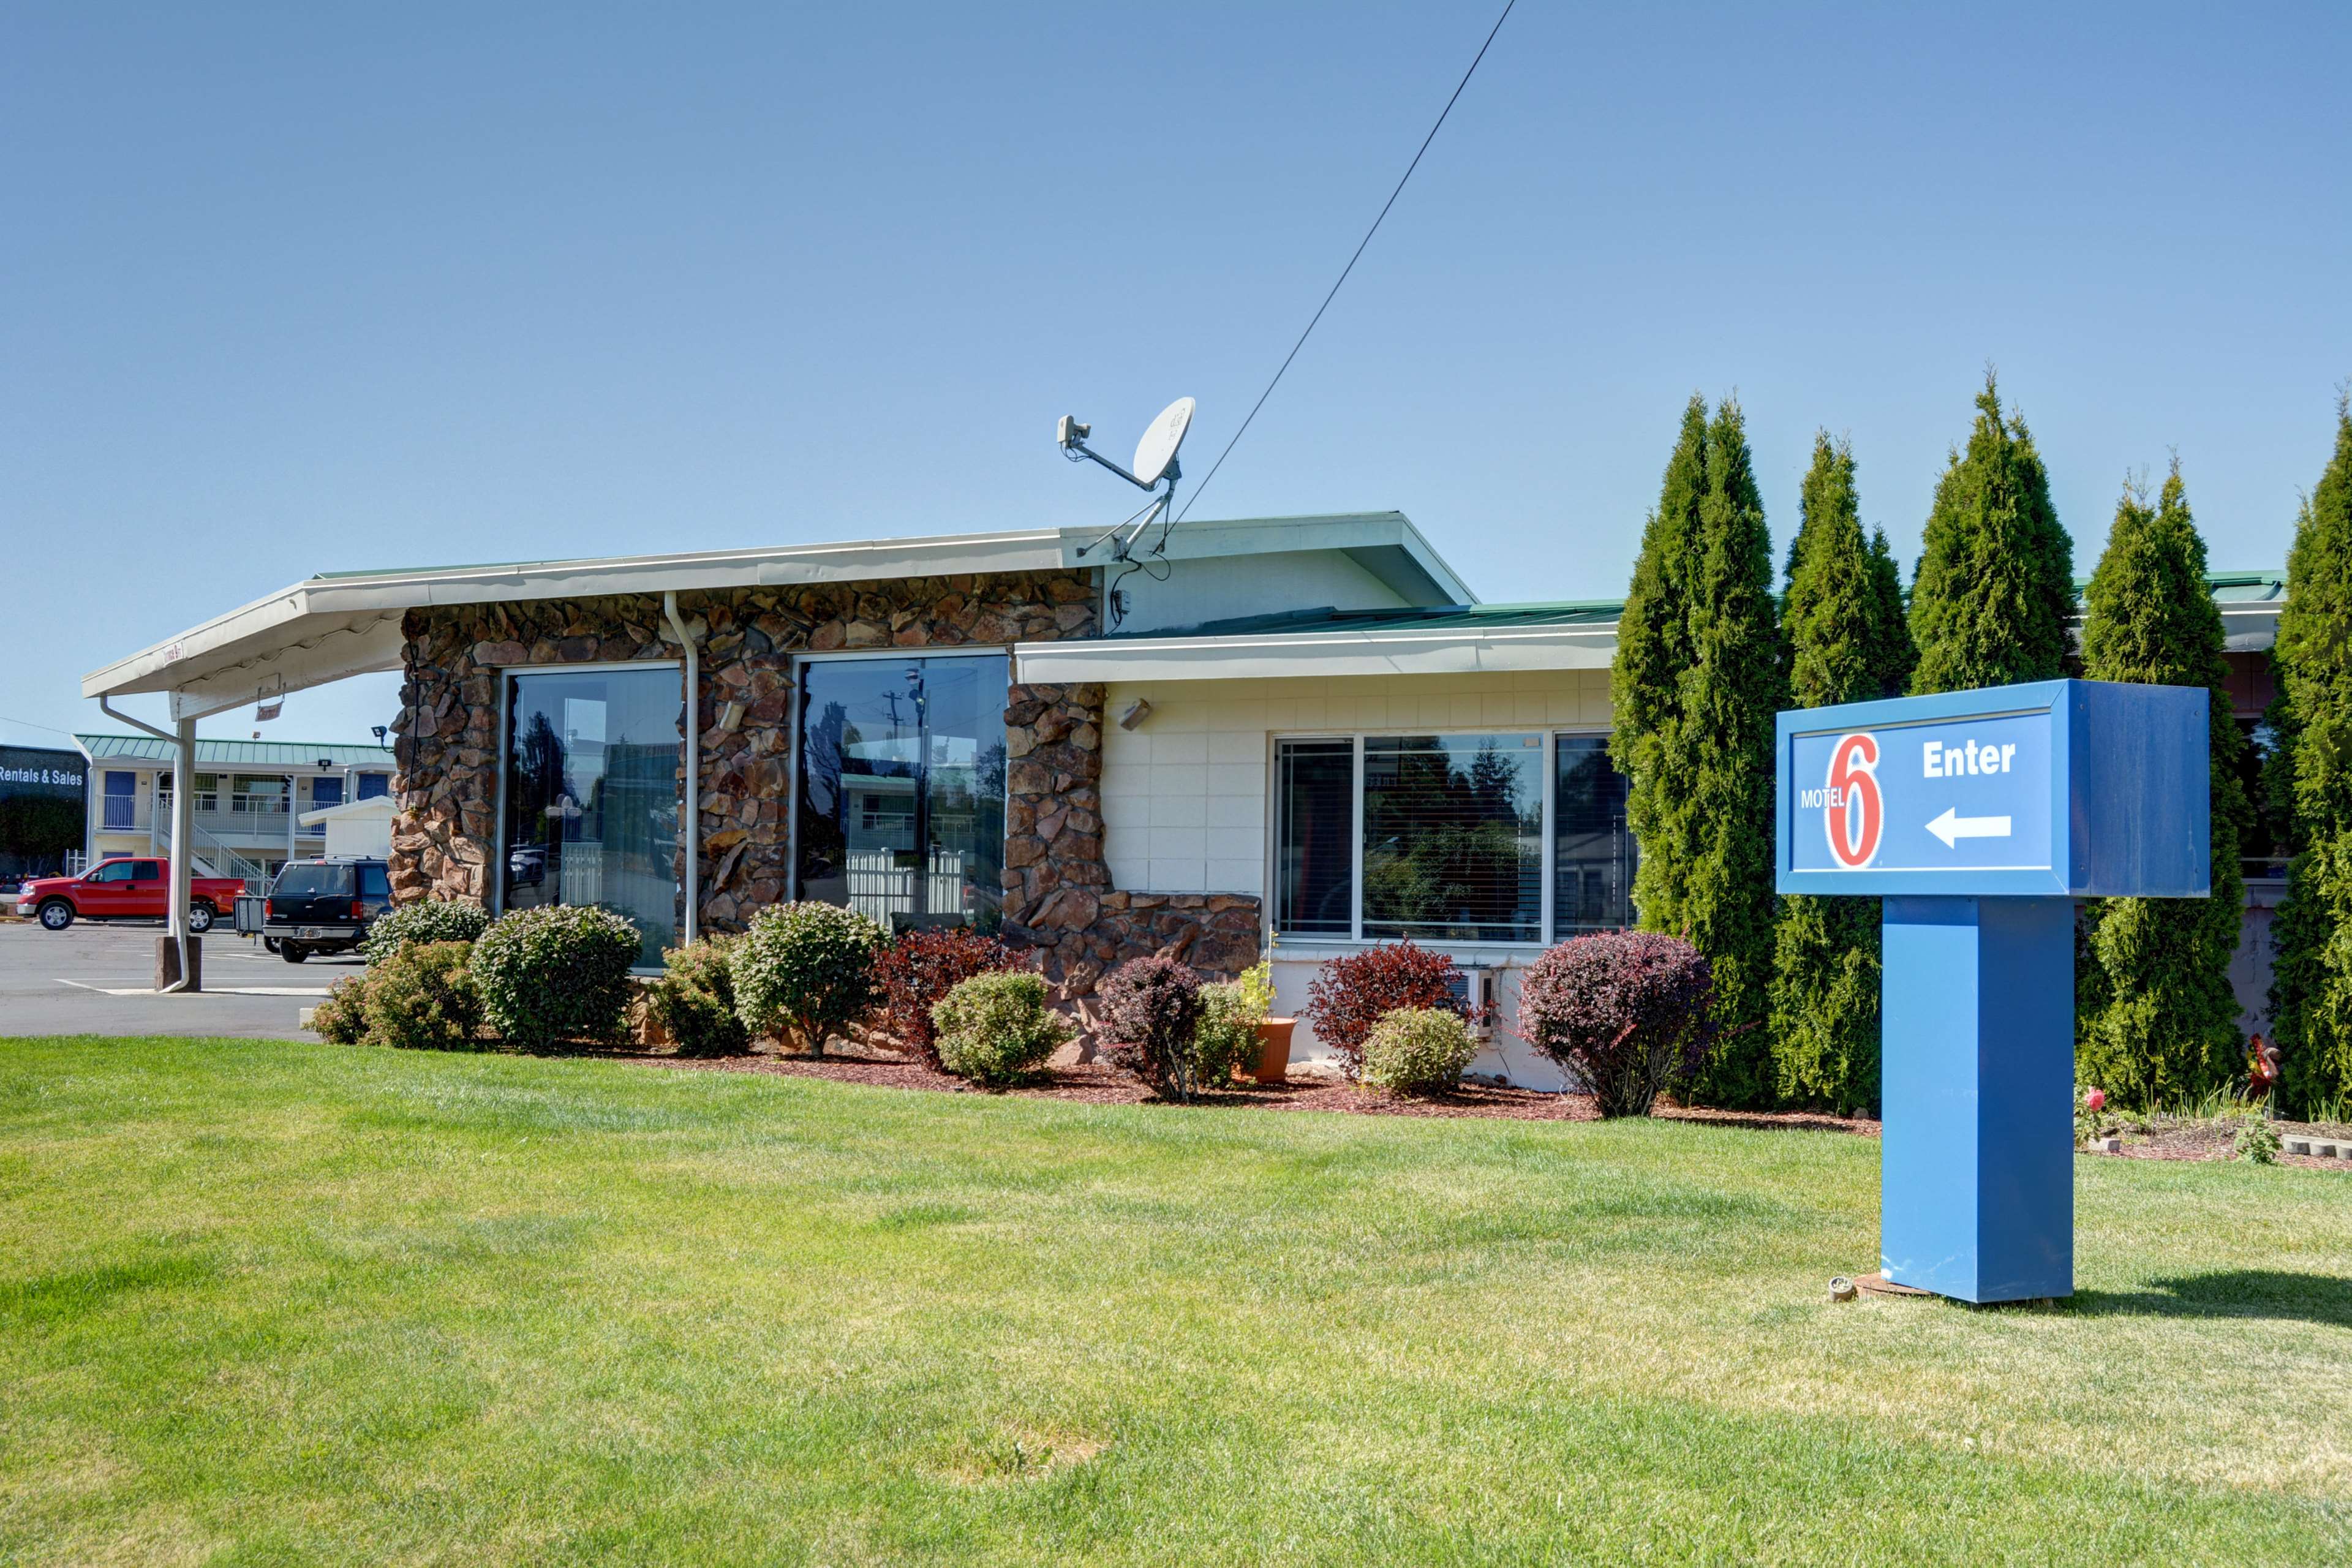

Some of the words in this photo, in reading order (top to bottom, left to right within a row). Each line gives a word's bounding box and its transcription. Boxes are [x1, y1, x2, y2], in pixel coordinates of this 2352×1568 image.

[0, 766, 39, 783] Rentals
[42, 769, 50, 784] &
[52, 770, 83, 786] Sales
[1923, 739, 2016, 778] Enter
[1801, 788, 1845, 809] MOTEL
[1828, 734, 1882, 867] 6
